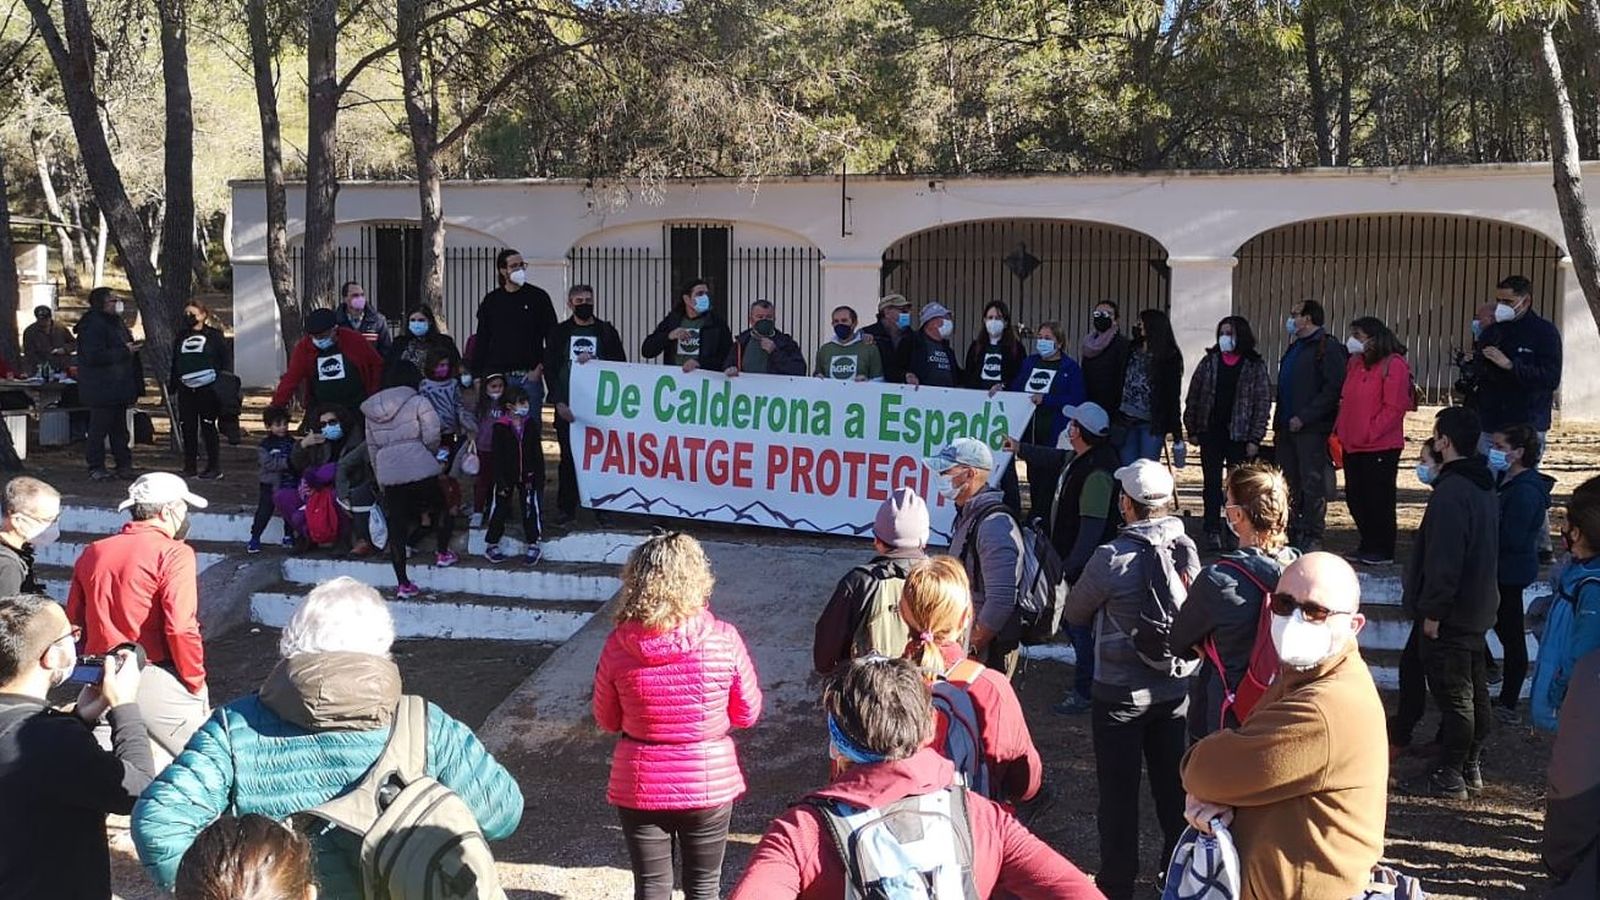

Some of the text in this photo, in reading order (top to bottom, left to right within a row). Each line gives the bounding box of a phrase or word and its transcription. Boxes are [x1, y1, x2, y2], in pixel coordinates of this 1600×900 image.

[595, 370, 1009, 457] De Calderona a Espadà
[582, 426, 946, 507] PAISATGE PROTEGI
